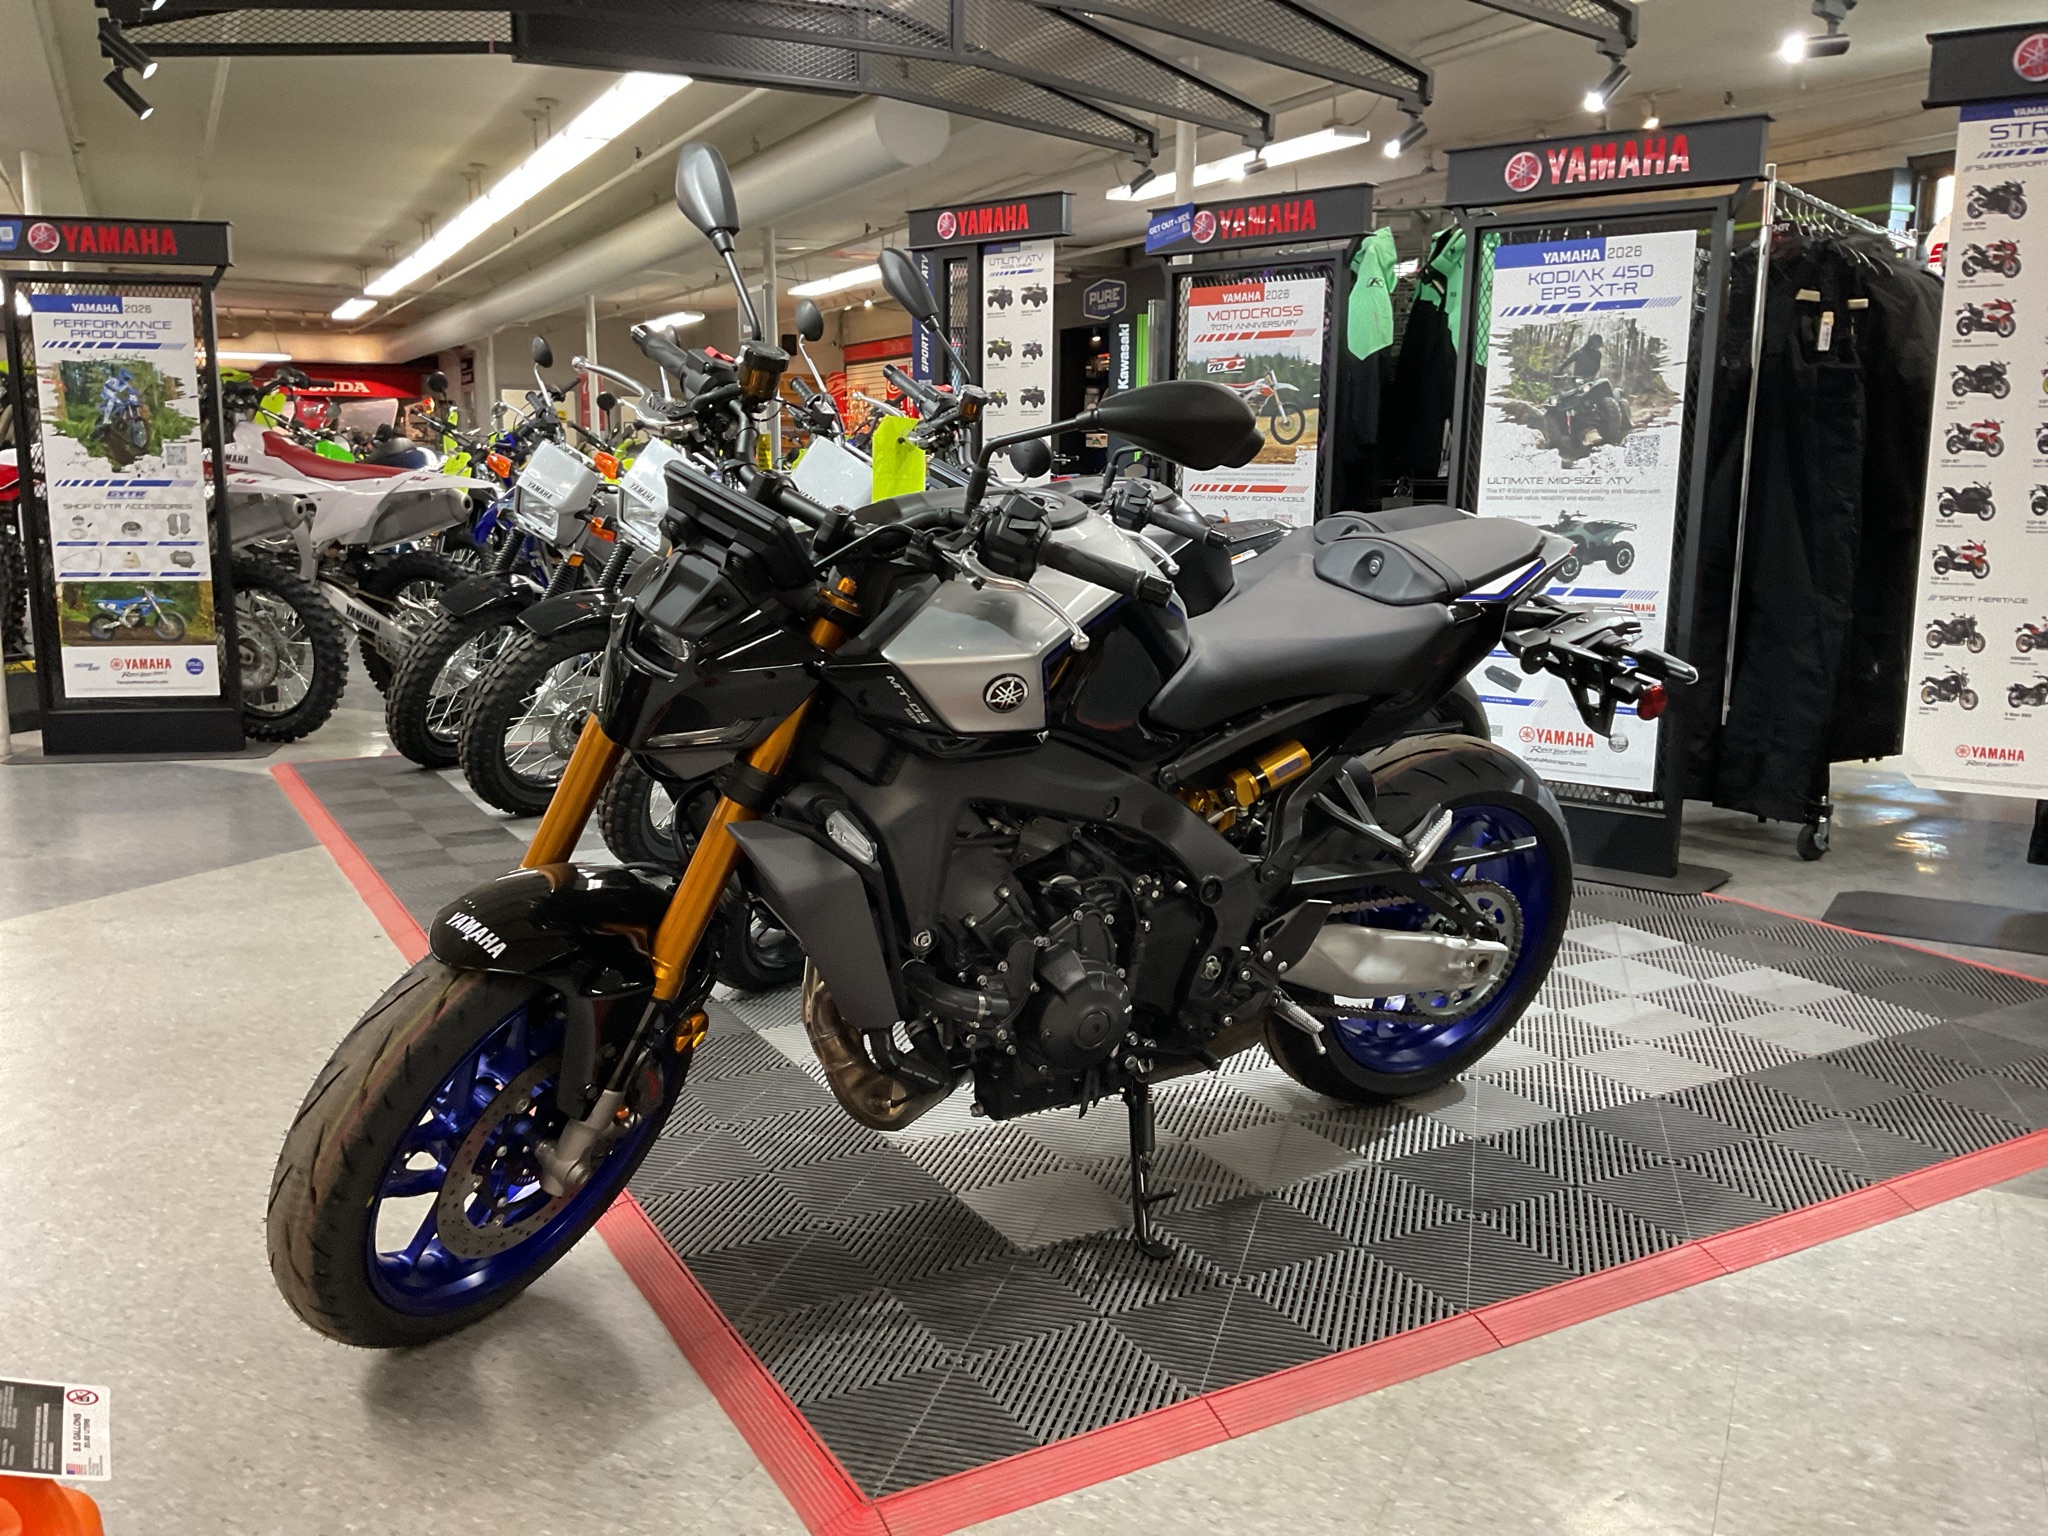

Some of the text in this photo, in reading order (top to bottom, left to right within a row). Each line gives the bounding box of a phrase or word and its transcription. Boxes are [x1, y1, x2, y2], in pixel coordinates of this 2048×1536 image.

[1547, 135, 1690, 185] YAMAHA
[958, 204, 1029, 236] YAMAHA
[1149, 225, 1161, 235] GET
[1161, 219, 1174, 231] OUT
[1177, 212, 1191, 224] RIDE
[1219, 200, 1316, 239] YAMAHA
[62, 225, 177, 256] YAMAHA
[989, 253, 1044, 266] UTILITY ATV
[1543, 246, 1643, 264] YAMAHA 2026
[921, 254, 929, 279] ATV
[1528, 263, 1654, 286] KODIAK 450
[1089, 287, 1121, 305] PURE
[1222, 290, 1290, 303] YAMAHA 2026
[1540, 281, 1638, 301] EPS XT-R
[72, 303, 152, 314] YAMAHA 2026
[1207, 305, 1304, 322] MOTOCROSS
[53, 319, 172, 330] PERFORMANCE
[70, 329, 157, 340] PRODUCTS
[1211, 319, 1298, 331] 70TH ANNIVERSARY
[921, 333, 929, 373] SPORT
[1118, 323, 1130, 390] Kawasaki
[225, 454, 248, 465] MAHA
[527, 480, 553, 501] YAMAHA
[1487, 476, 1633, 485] ULTIMATE MID-SIZE ATV
[629, 481, 656, 504] YAMAHA
[1978, 596, 2029, 604] HERITAGE
[346, 603, 380, 632] YAMAHA
[124, 658, 171, 670] YAMAHA
[886, 675, 931, 724] MT-09
[1536, 729, 1594, 748] YAMAHA
[1972, 746, 2025, 762] YAMAHA
[446, 911, 507, 960] YAMAHA
[73, 1413, 82, 1441] GALLONS
